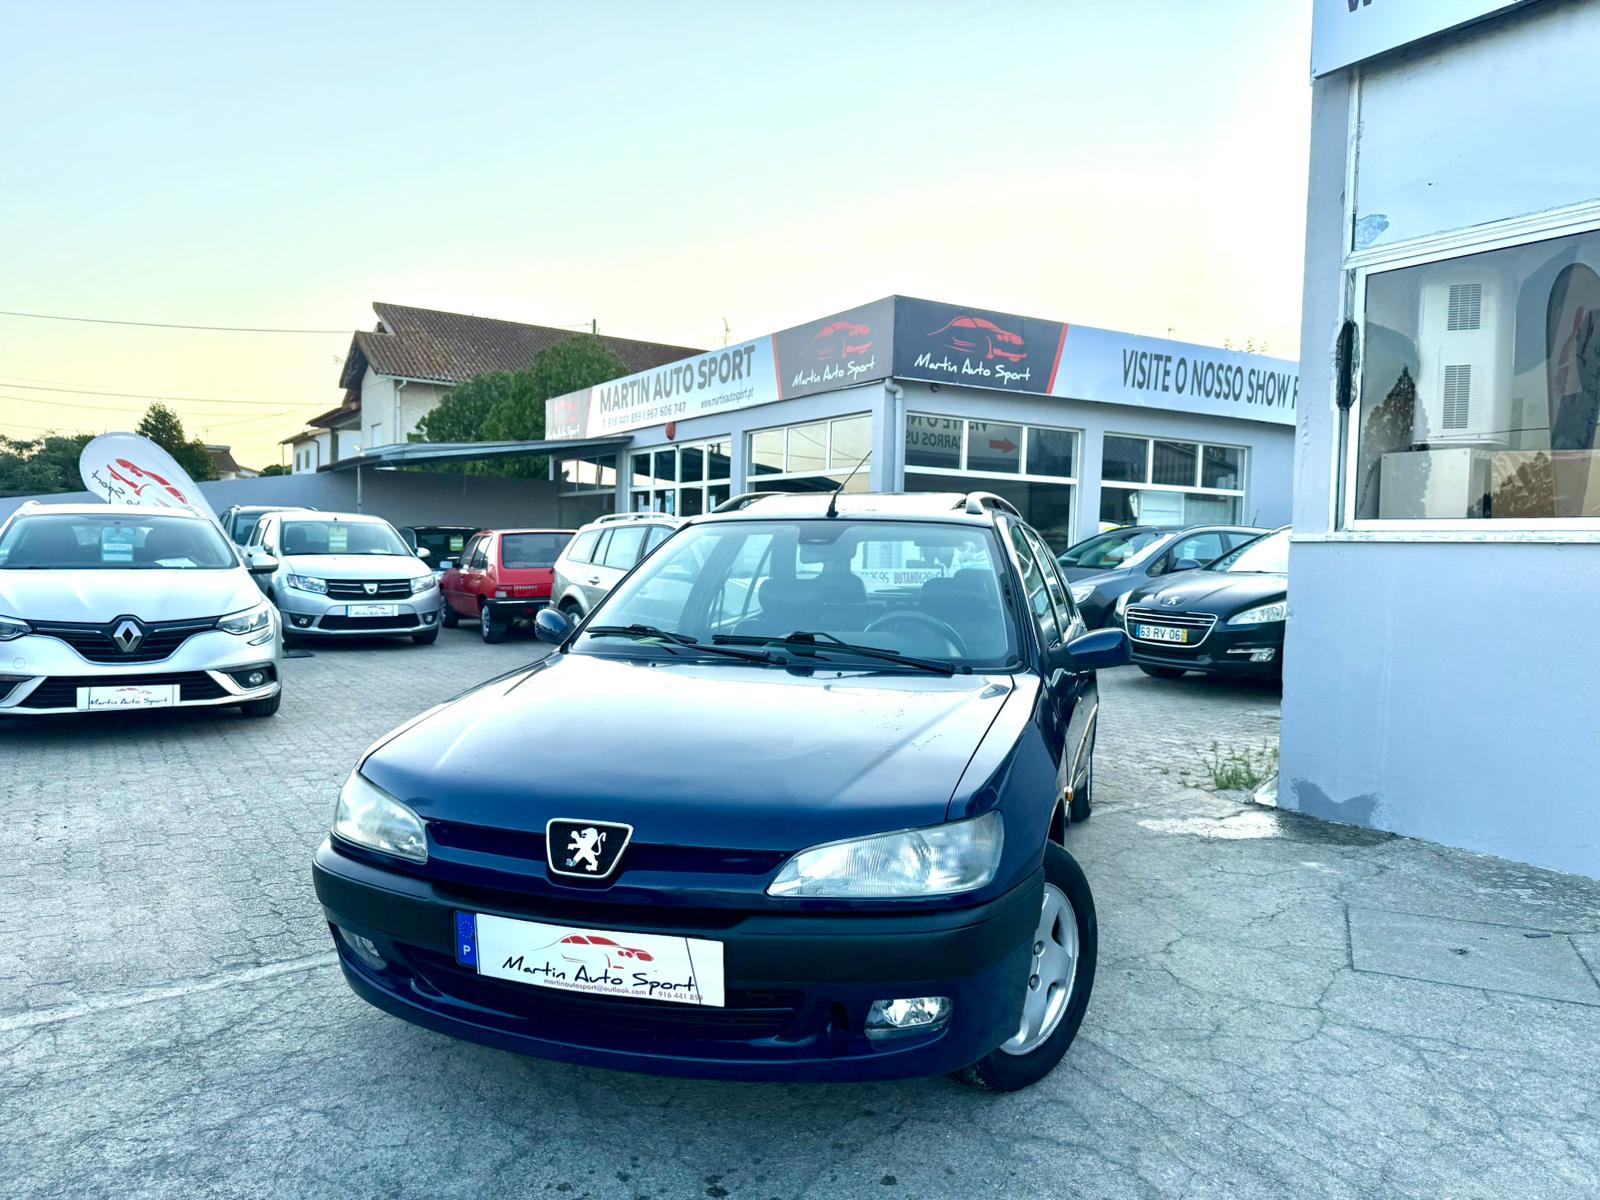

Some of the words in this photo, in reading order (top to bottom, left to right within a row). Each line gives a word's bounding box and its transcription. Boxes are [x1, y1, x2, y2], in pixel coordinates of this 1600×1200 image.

[600, 375, 650, 414] MARTIN
[653, 365, 694, 403] AUTO
[697, 345, 755, 390] SPORT
[792, 370, 821, 388] Martin
[823, 363, 846, 381] Auto
[848, 354, 875, 379] Sport
[914, 352, 957, 374] Martin
[962, 358, 991, 378] Auto
[995, 365, 1031, 390] Sport
[1122, 348, 1172, 393] VISITE
[1175, 357, 1187, 395] O
[1190, 361, 1244, 402] NOSSO
[1246, 368, 1291, 409] SHOW
[673, 401, 687, 414] 747
[463, 945, 471, 956] P
[502, 955, 566, 980] Martin
[574, 964, 623, 986] Auto
[632, 972, 696, 996] Sport
[658, 990, 672, 999] 916
[674, 992, 688, 1000] 441
